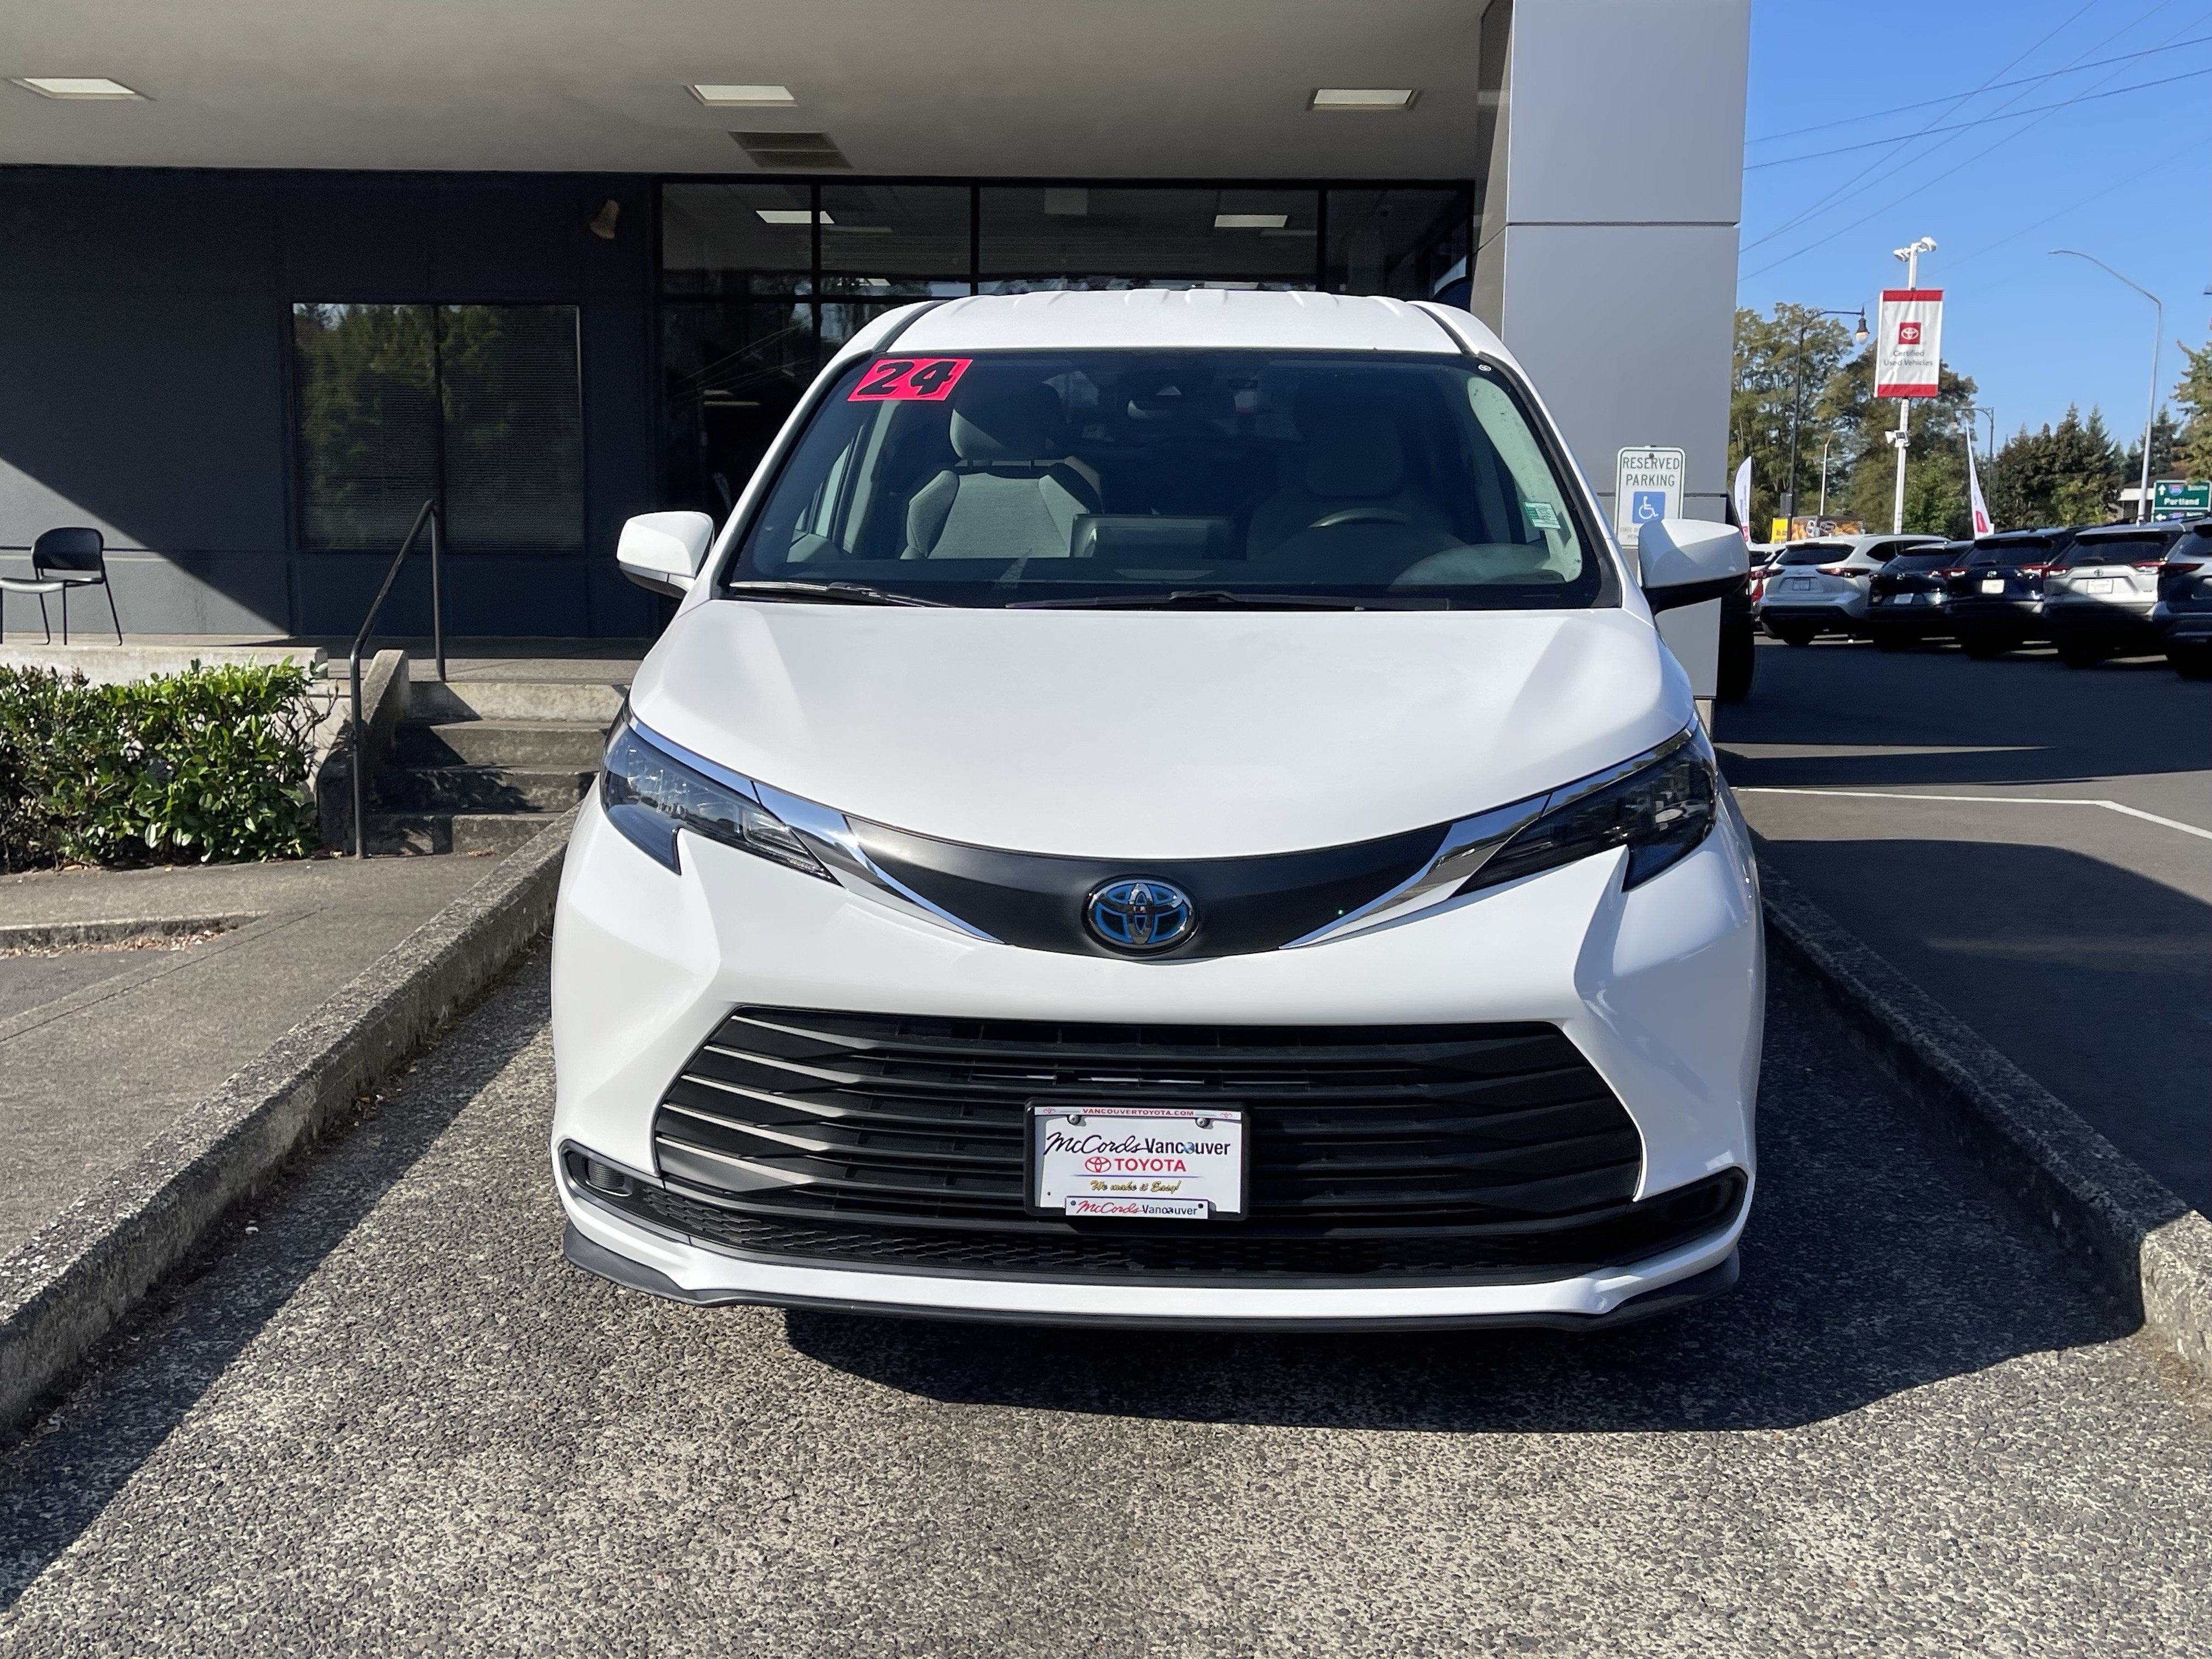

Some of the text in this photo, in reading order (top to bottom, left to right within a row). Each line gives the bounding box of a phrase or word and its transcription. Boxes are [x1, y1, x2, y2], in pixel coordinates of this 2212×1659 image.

[856, 360, 958, 396] 24
[1622, 456, 1680, 470] RESERVED
[1626, 474, 1675, 487] PARKING
[2164, 497, 2200, 505] Portland
[1082, 1108, 1194, 1116] VANCOUVERTOYOTA.COM
[1145, 1137, 1231, 1156] Vancouver
[1114, 1158, 1187, 1172] TOYOTA
[1090, 1180, 1182, 1194] We make it Easy!
